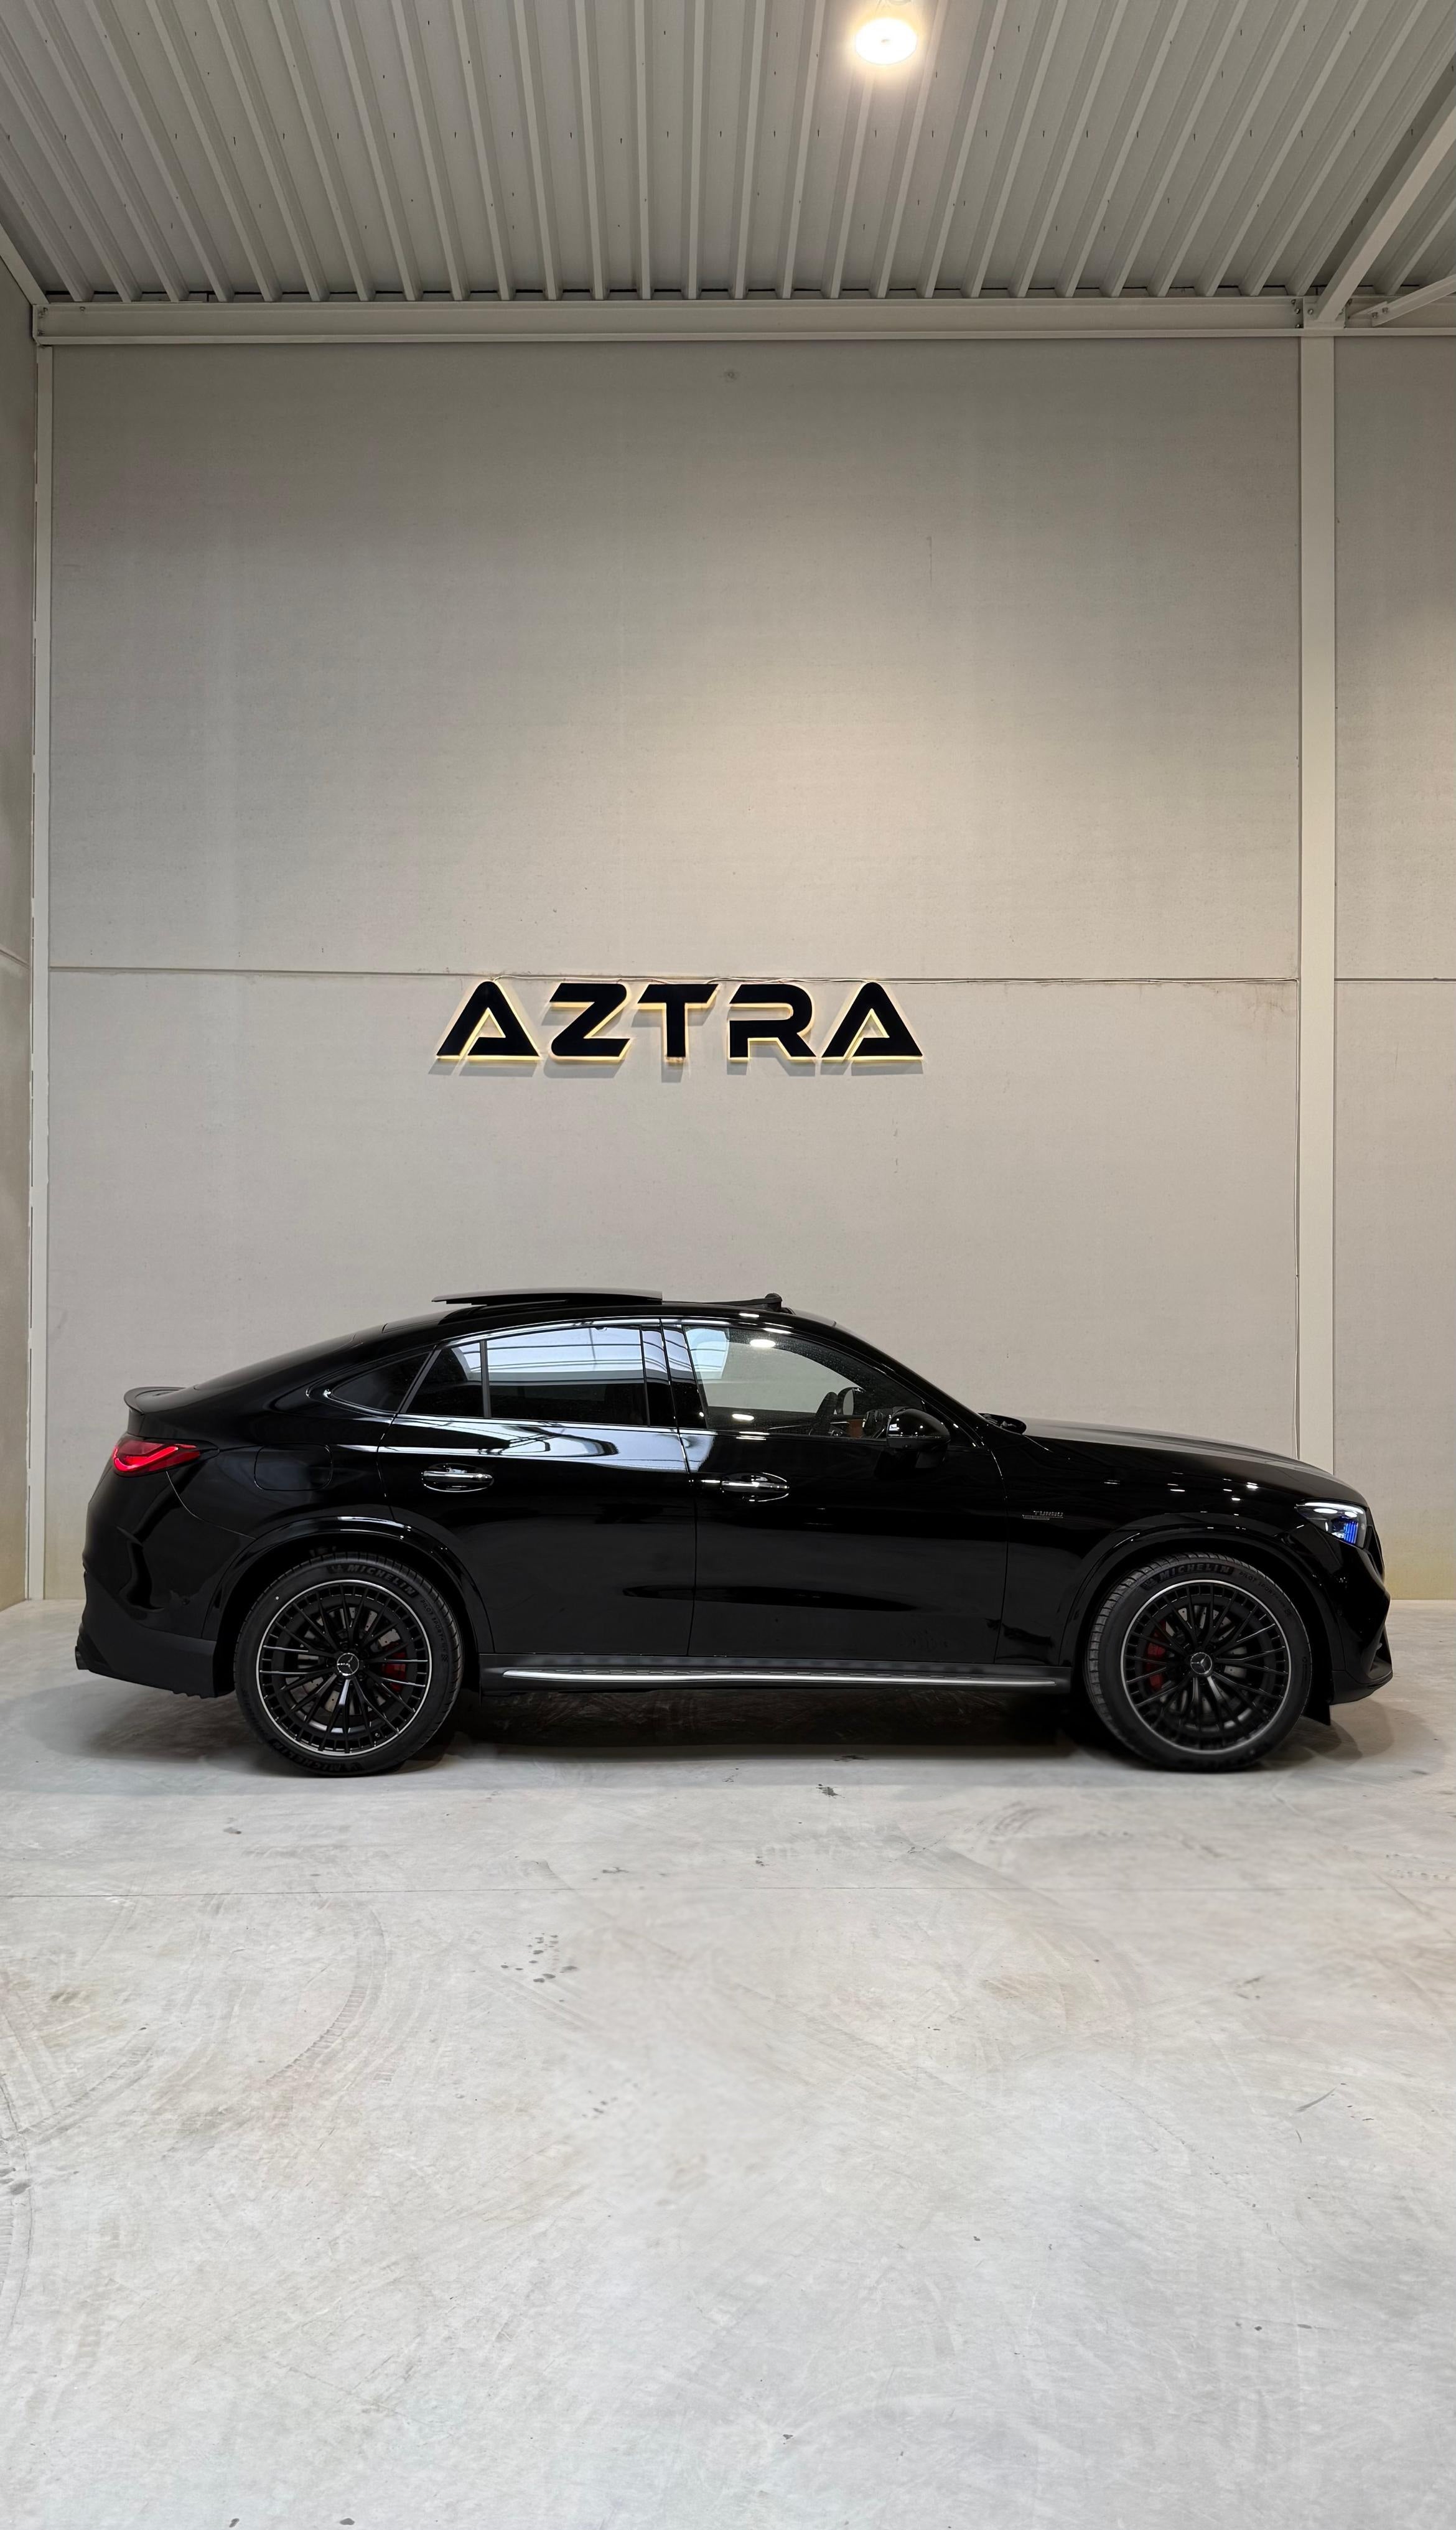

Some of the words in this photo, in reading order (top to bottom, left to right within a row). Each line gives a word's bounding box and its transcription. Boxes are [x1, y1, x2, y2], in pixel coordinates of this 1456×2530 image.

[437, 981, 923, 1060] AZTRA
[347, 1564, 415, 1596] MICHELIN
[1159, 1563, 1230, 1580] MICHELIN
